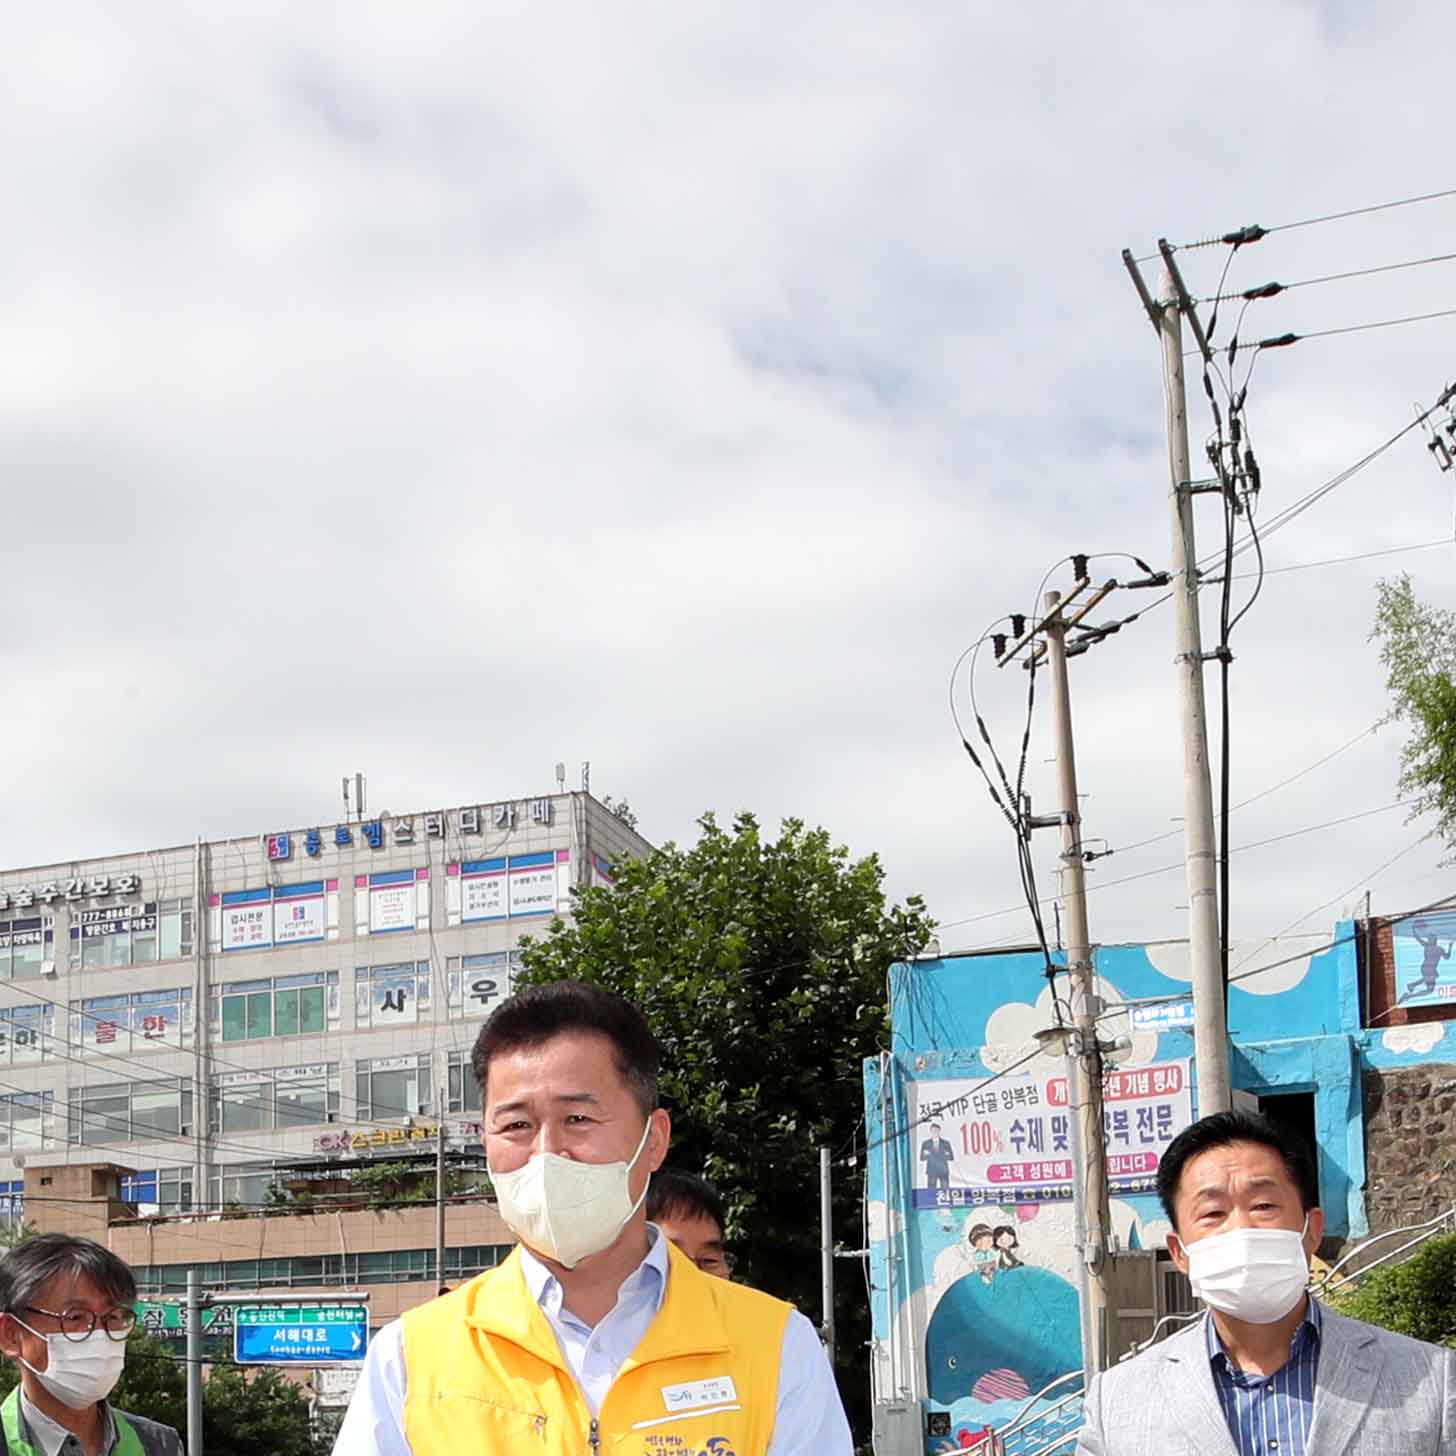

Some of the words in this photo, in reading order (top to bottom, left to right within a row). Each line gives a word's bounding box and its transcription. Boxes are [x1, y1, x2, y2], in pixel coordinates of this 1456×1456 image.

[947, 1099, 968, 1117] VIP
[974, 1091, 998, 1114] 단골
[1001, 1086, 1039, 1110] 양복점
[1126, 1074, 1148, 1095] 기념
[1153, 1069, 1179, 1092] 행사
[960, 1121, 1003, 1156] 100%
[1010, 1116, 1044, 1154] 수제
[1137, 1104, 1174, 1143] 전문
[1000, 1165, 1027, 1181] 고객
[1030, 1161, 1066, 1180] 성원에
[273, 1328, 328, 1342] 서해대로
